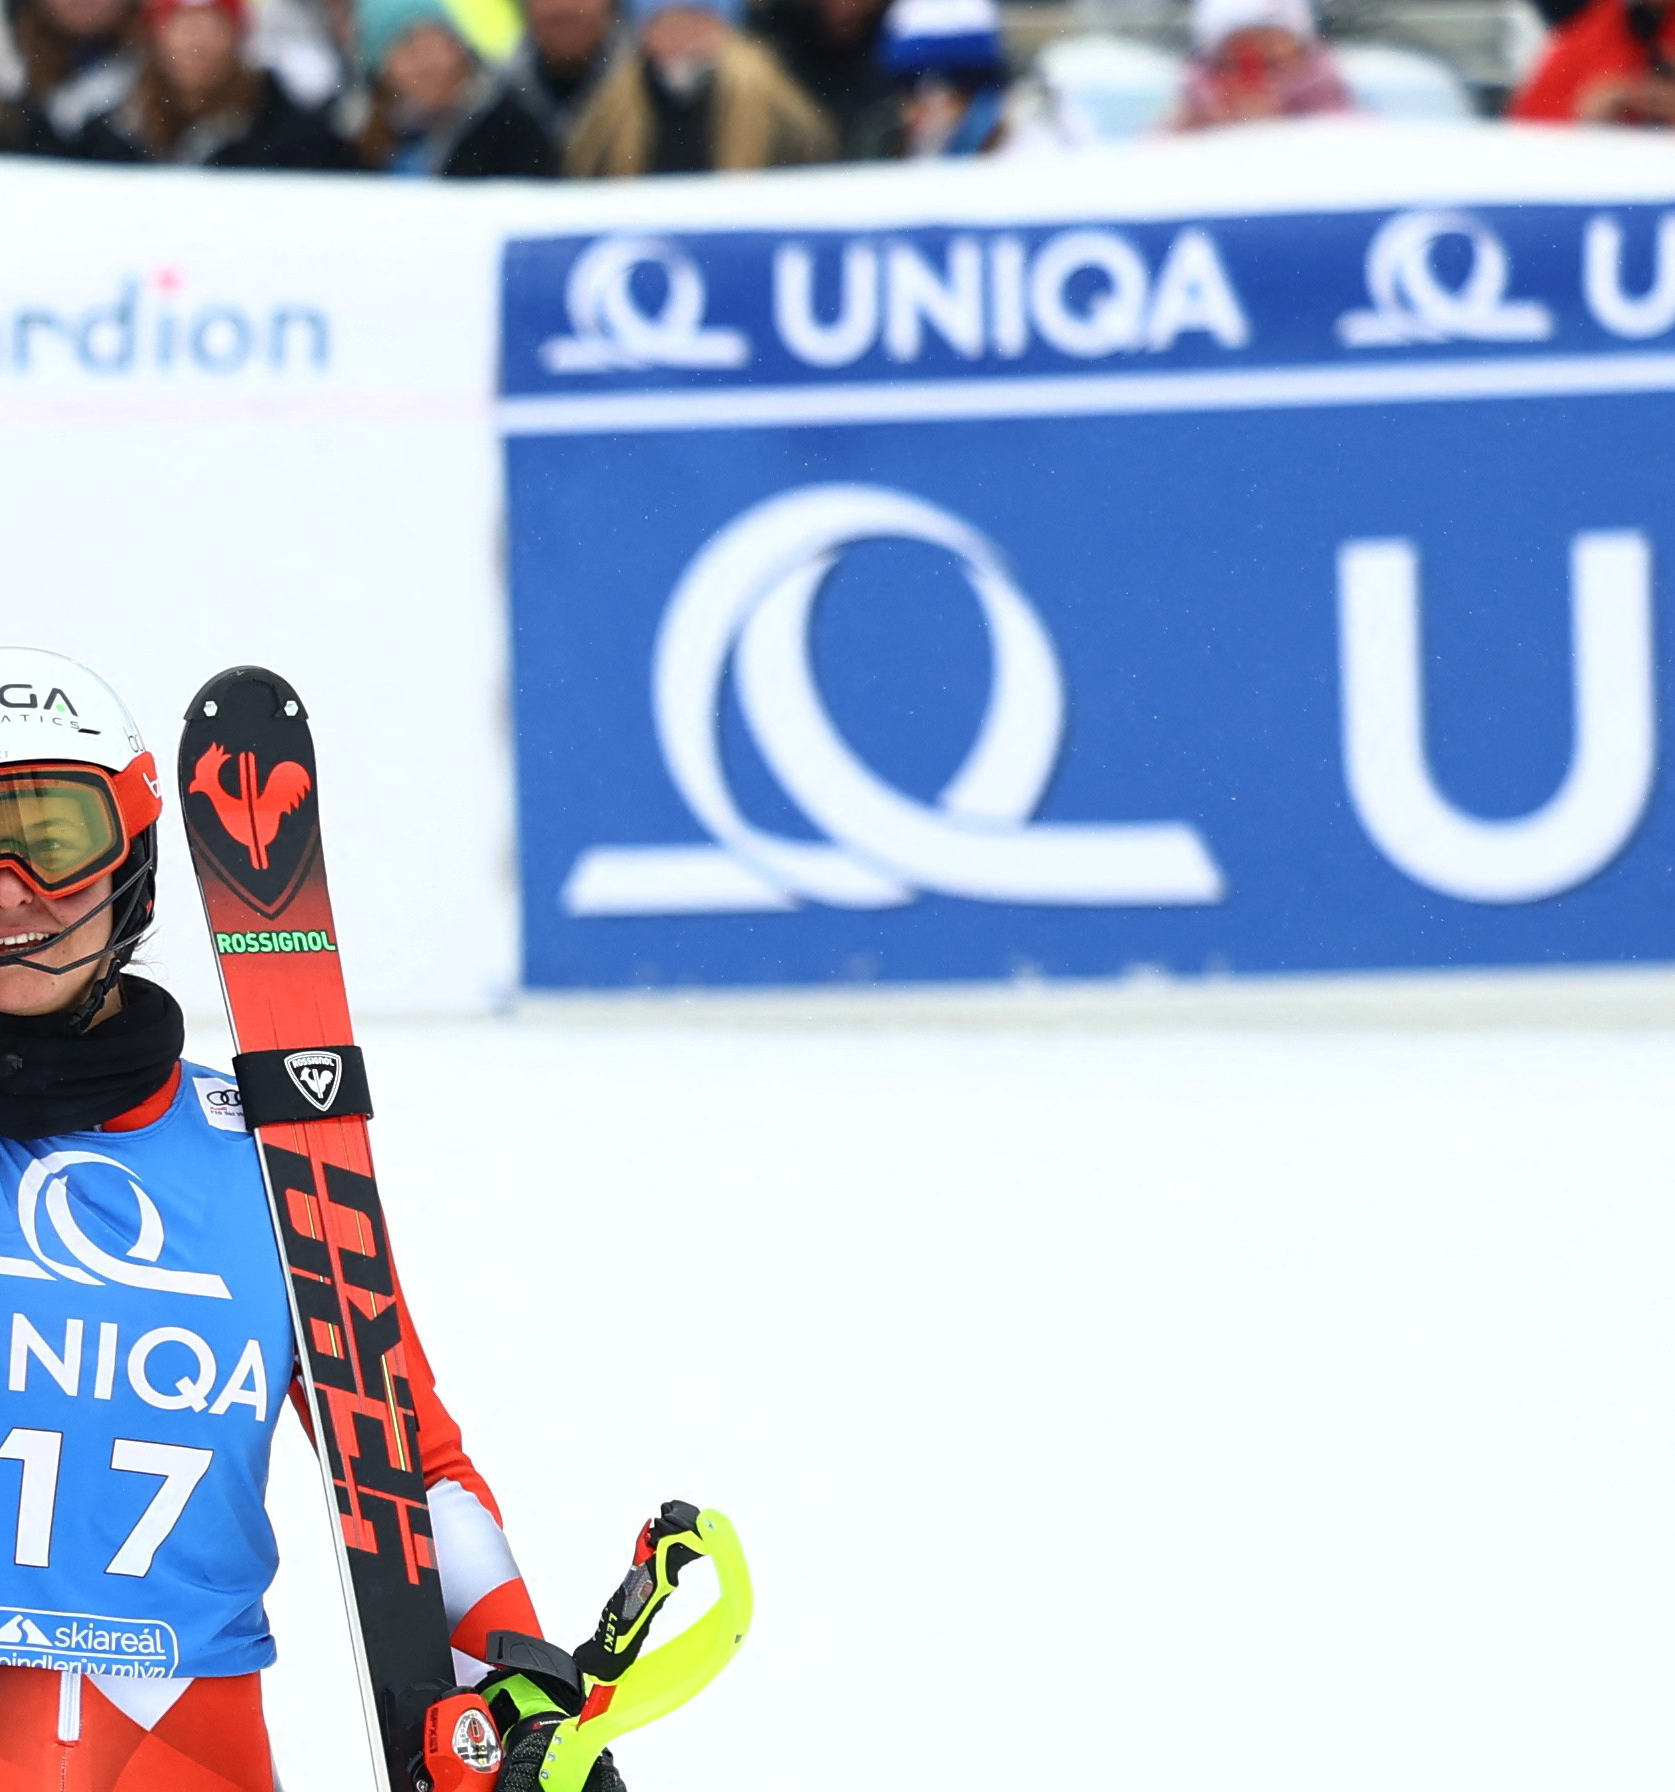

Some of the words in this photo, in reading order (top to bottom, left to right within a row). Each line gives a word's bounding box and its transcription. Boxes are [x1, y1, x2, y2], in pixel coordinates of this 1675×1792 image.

[768, 226, 1253, 368] UNIQA
[216, 929, 337, 955] ROSSIGNOL
[292, 1055, 336, 1071] ROSSIGNOL
[53, 1621, 166, 1654] skiareál
[603, 1611, 619, 1653] LEKI
